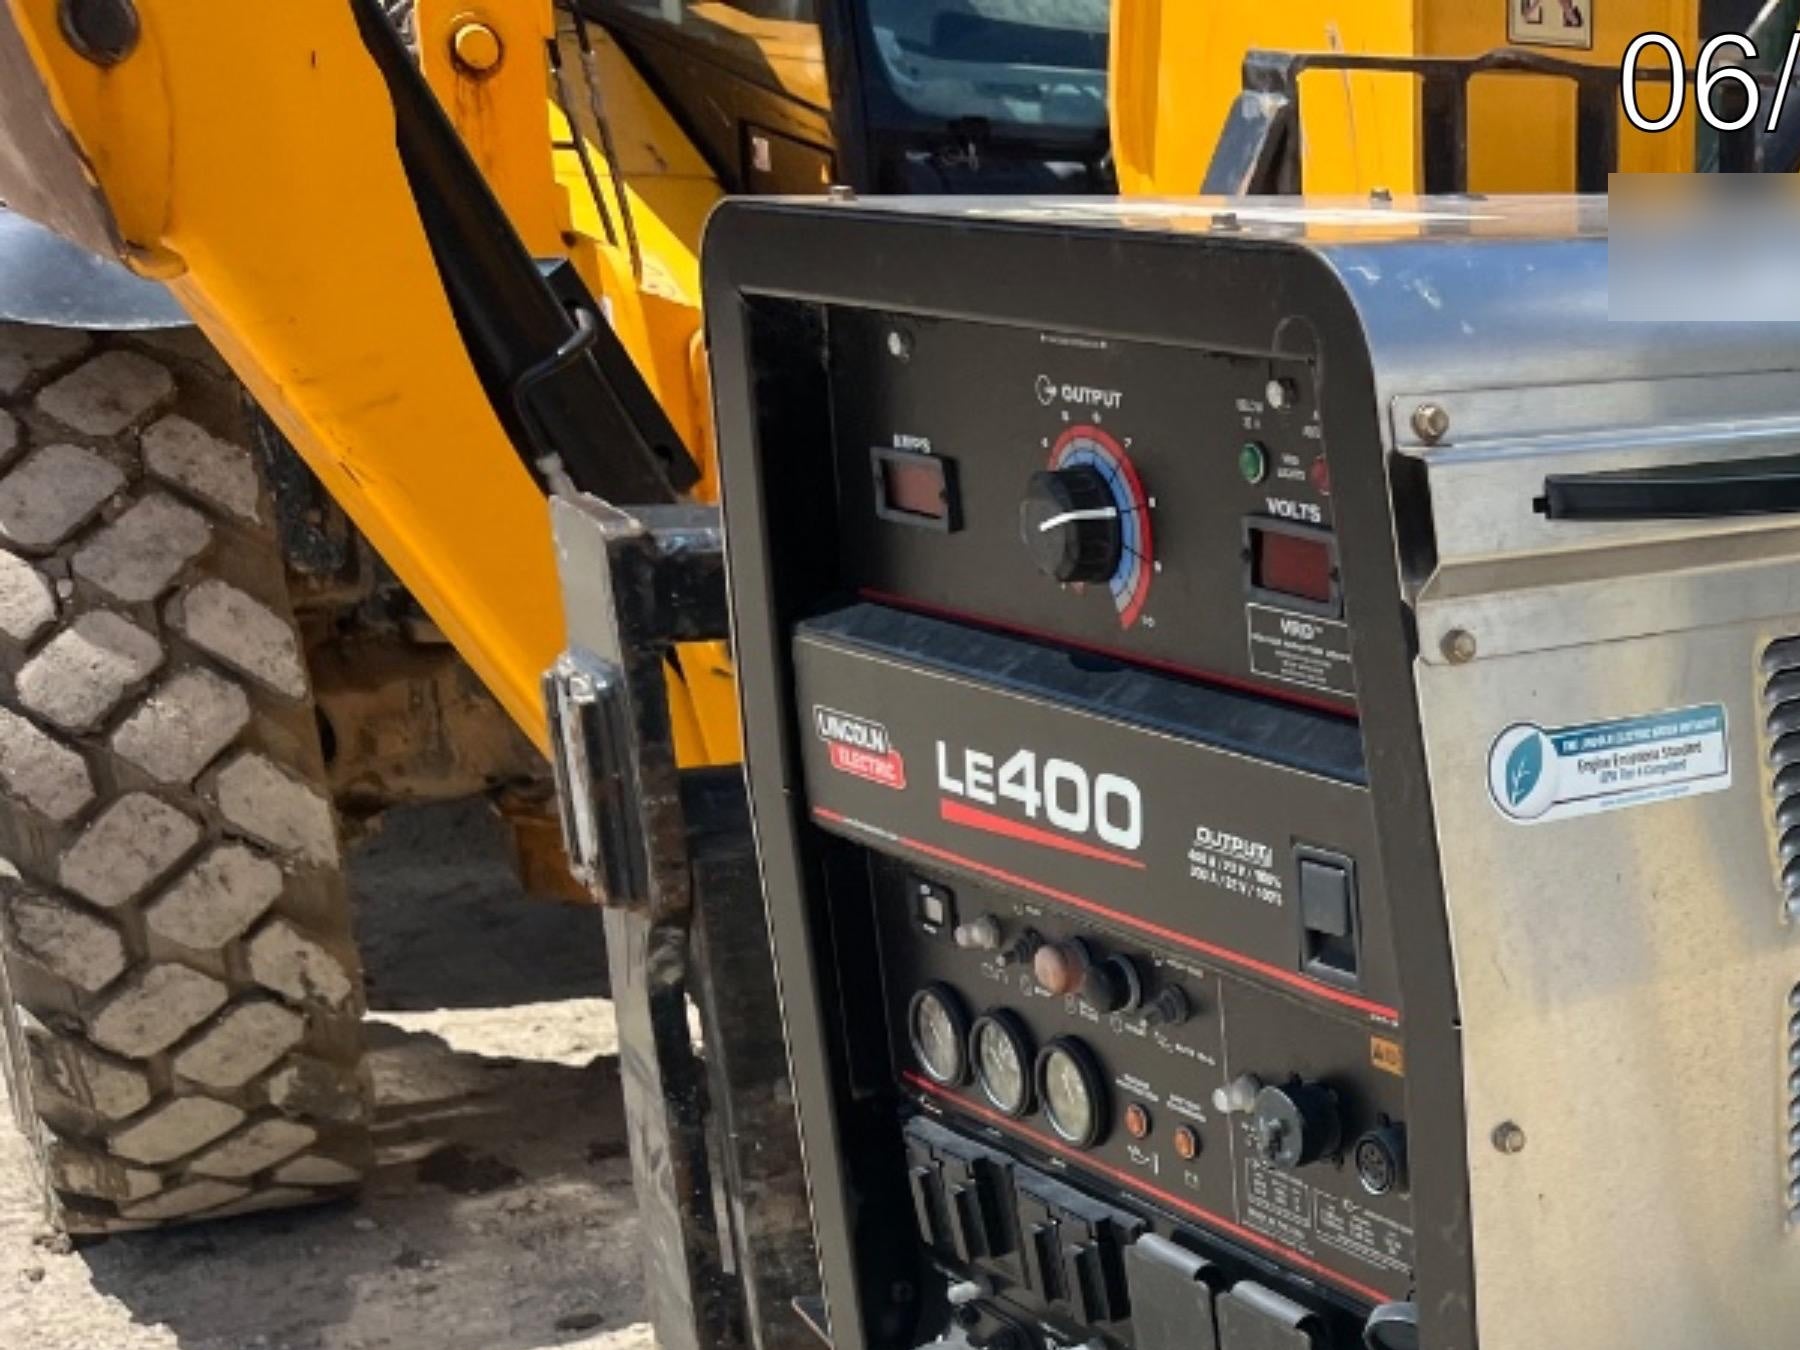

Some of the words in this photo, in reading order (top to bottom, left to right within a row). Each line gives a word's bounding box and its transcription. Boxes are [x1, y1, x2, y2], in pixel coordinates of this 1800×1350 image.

[1061, 383, 1123, 409] OUTPUT
[1265, 497, 1322, 524] VOLTS
[936, 740, 1143, 849] LE400
[1195, 826, 1267, 859] OUTPUT
